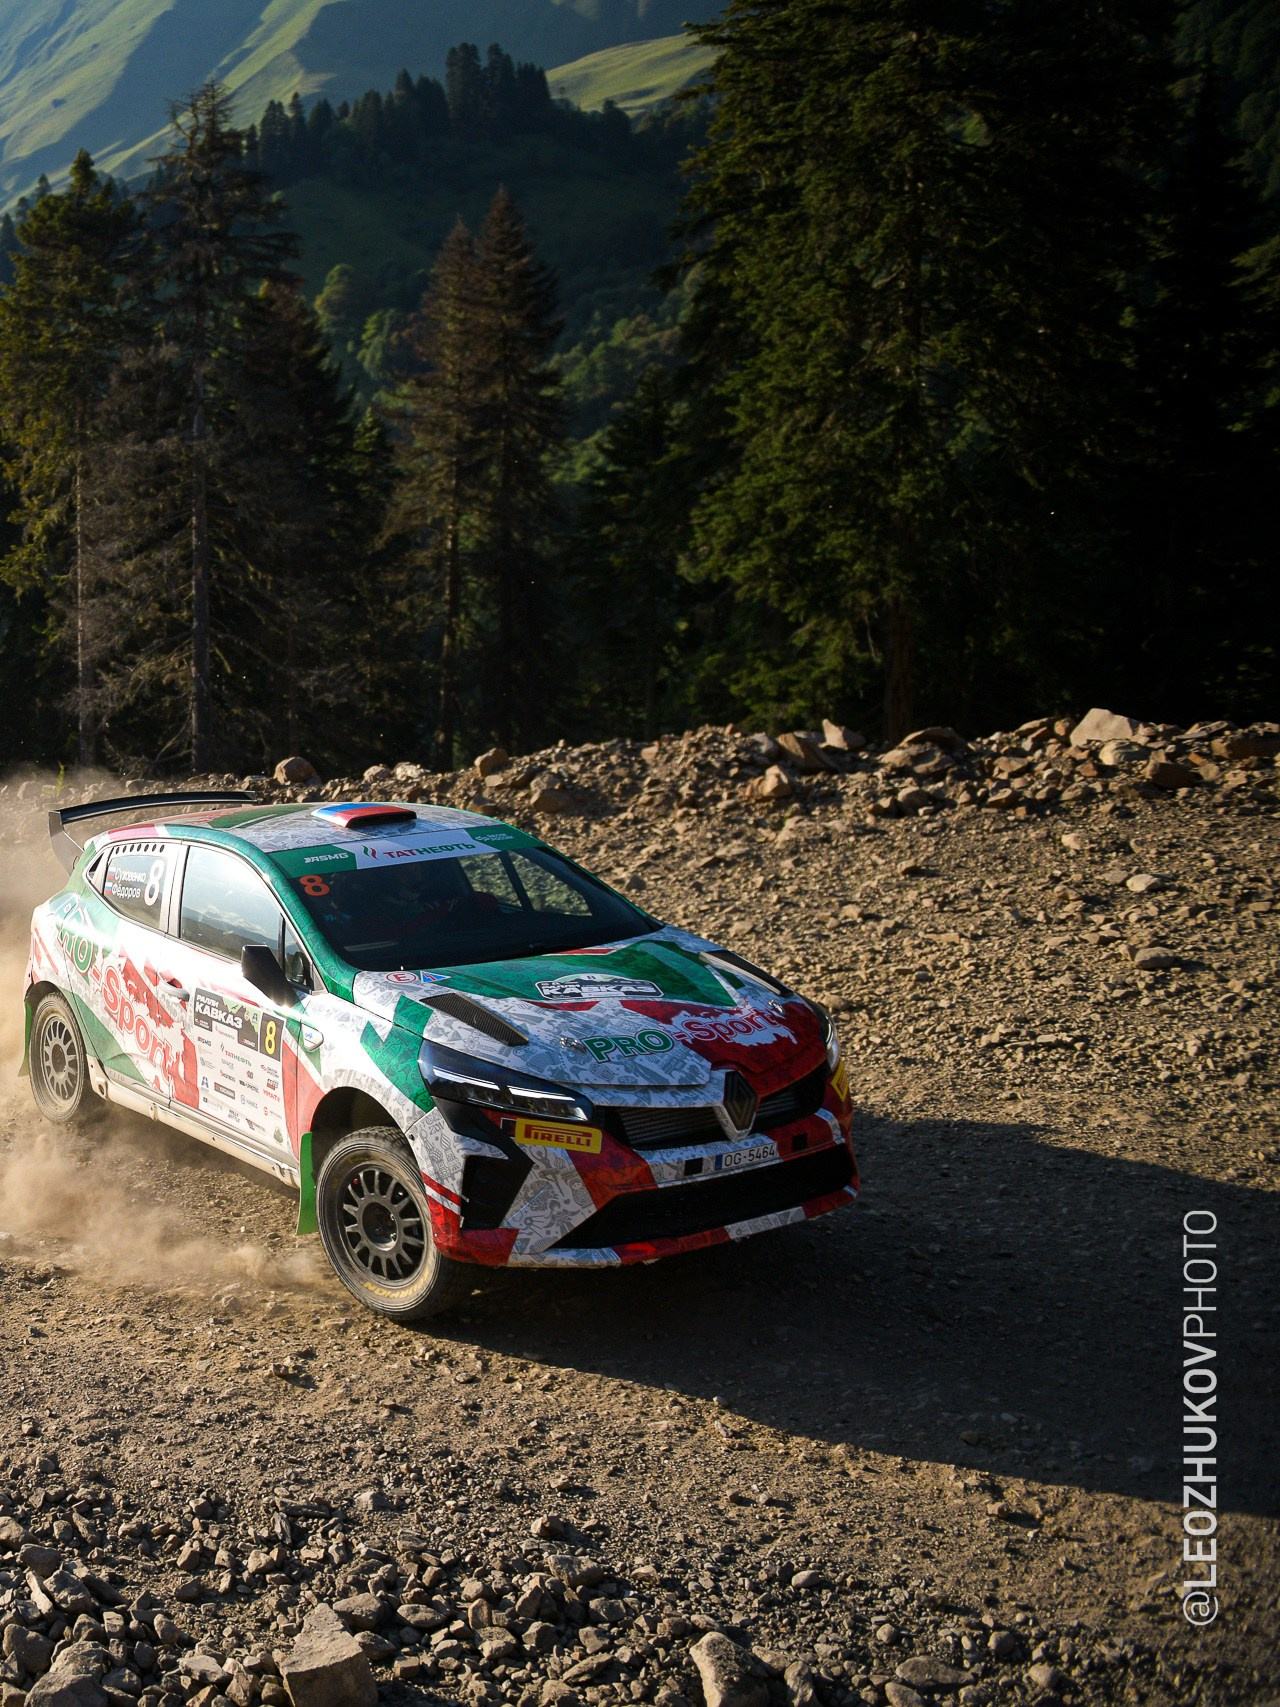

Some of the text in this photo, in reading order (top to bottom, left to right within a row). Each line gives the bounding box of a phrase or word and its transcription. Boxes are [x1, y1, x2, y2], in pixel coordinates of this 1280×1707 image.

[382, 842, 476, 859] ТАТНЕФТЬ
[111, 883, 141, 899] Фёдоров
[144, 859, 165, 906] 8
[299, 874, 330, 897] 8
[195, 1001, 243, 1029] КАВКАЗ
[265, 1020, 276, 1055] 8
[524, 1123, 592, 1147] PIRELLI
